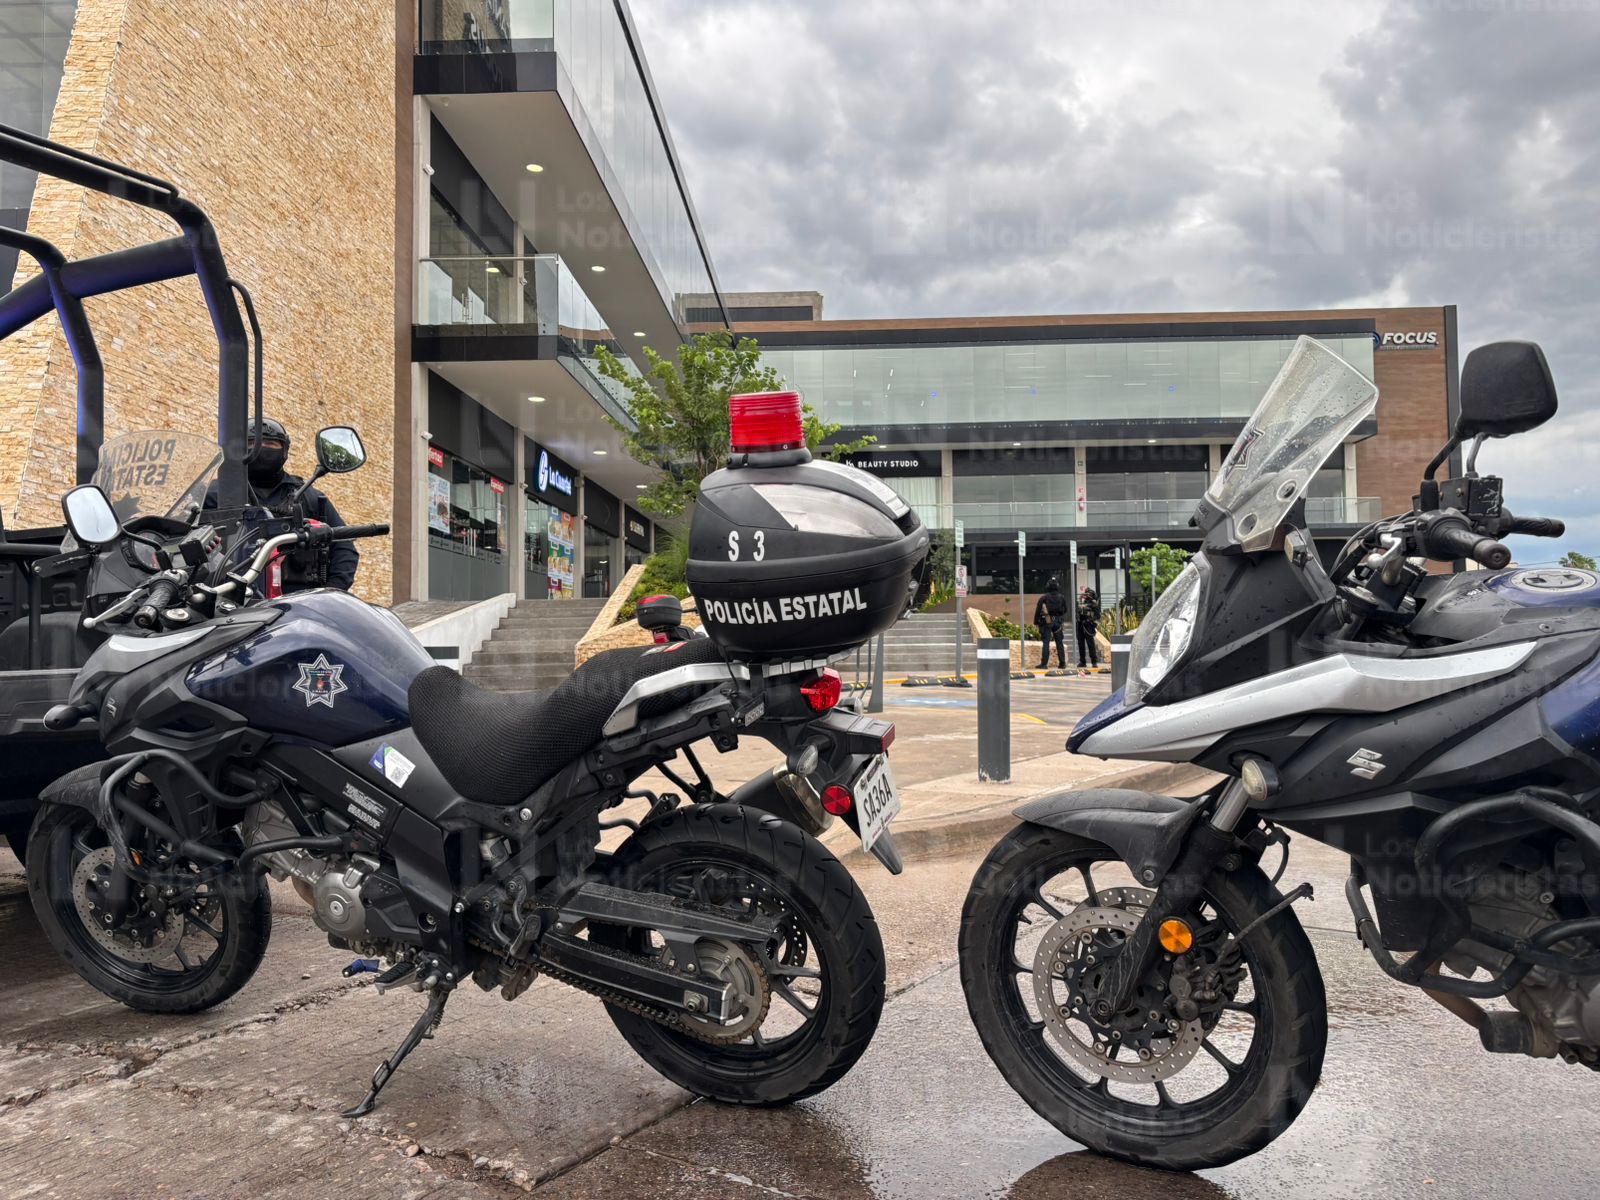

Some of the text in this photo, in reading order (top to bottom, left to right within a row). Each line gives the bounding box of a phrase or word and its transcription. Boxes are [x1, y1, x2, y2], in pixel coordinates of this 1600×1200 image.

[890, 460, 919, 468] STUDIO
[728, 530, 765, 562] S 3
[704, 588, 868, 625] POLICÍA ESTATAL
